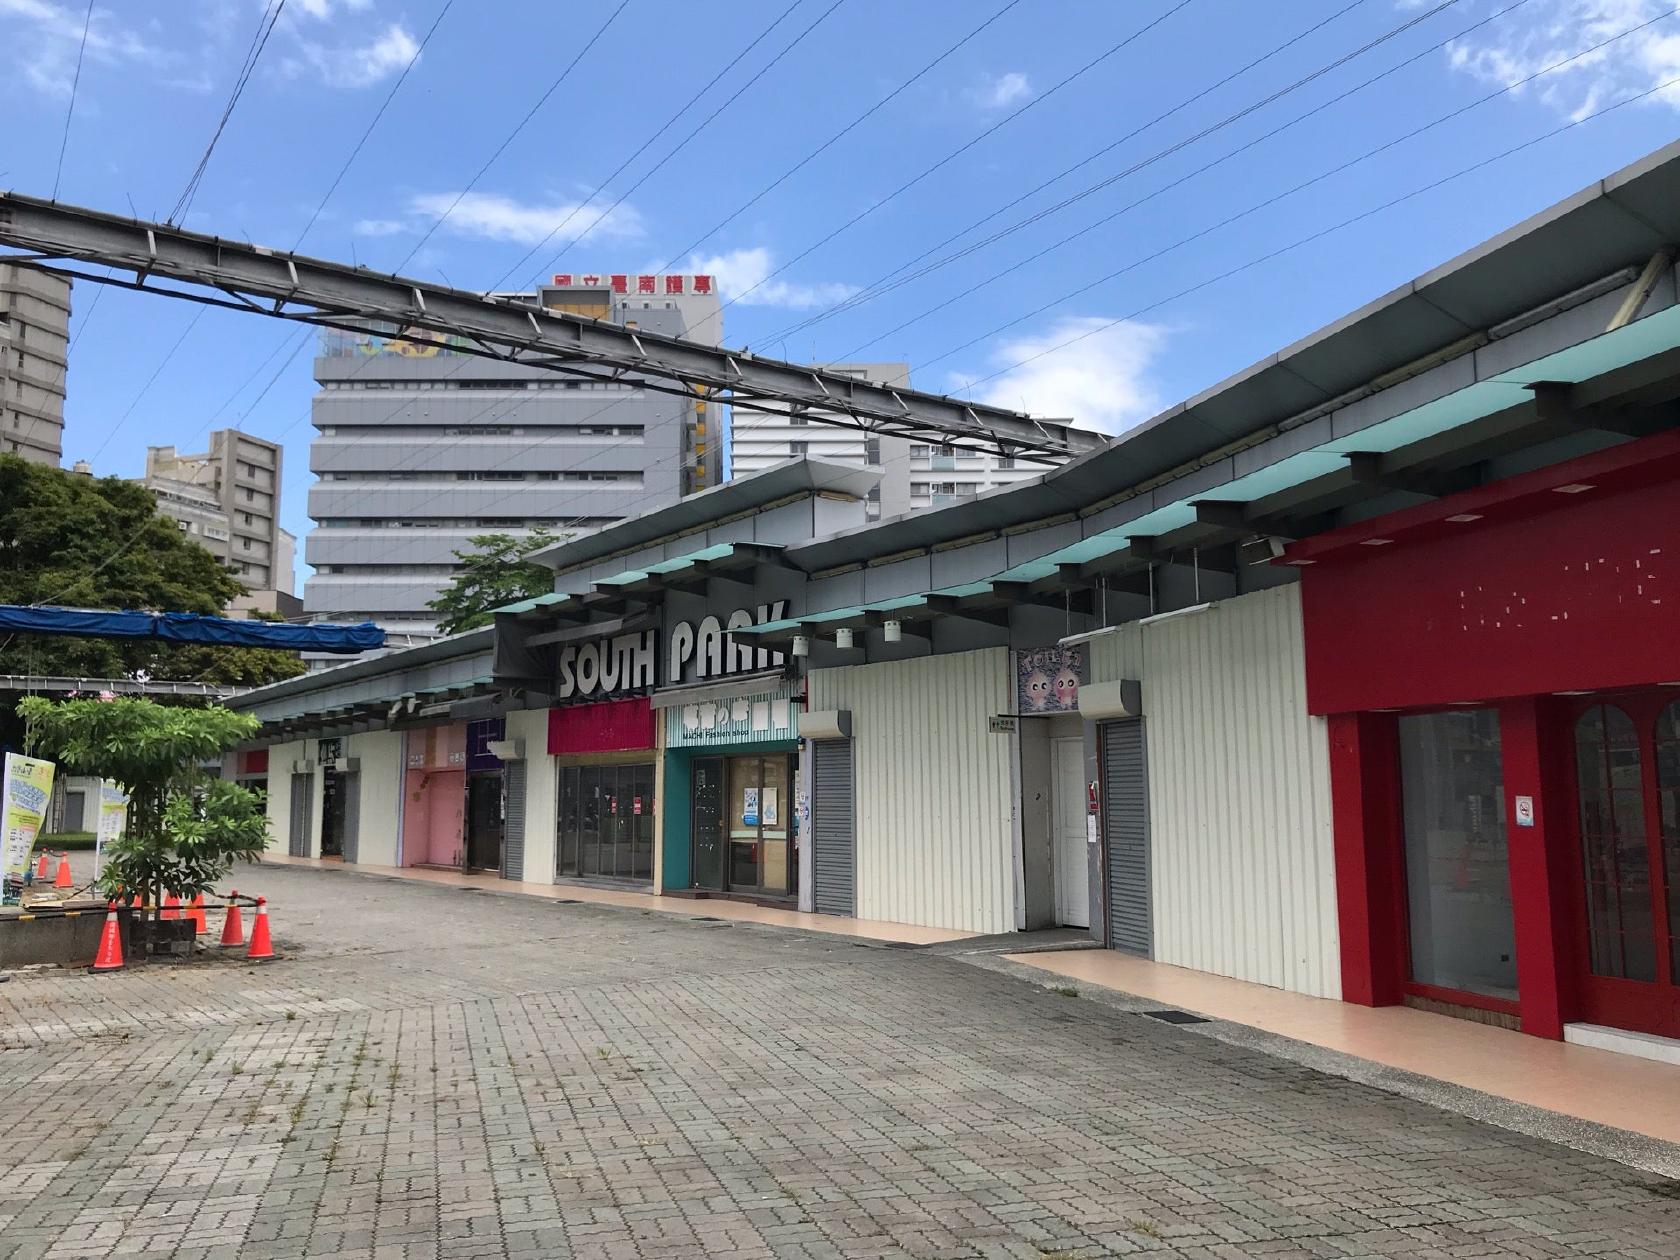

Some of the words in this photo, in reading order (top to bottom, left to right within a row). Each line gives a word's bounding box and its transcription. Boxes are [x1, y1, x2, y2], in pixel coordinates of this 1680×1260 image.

[559, 629, 656, 699] SOUTH
[671, 601, 786, 681] PARK
[705, 730, 730, 739] Fashion
